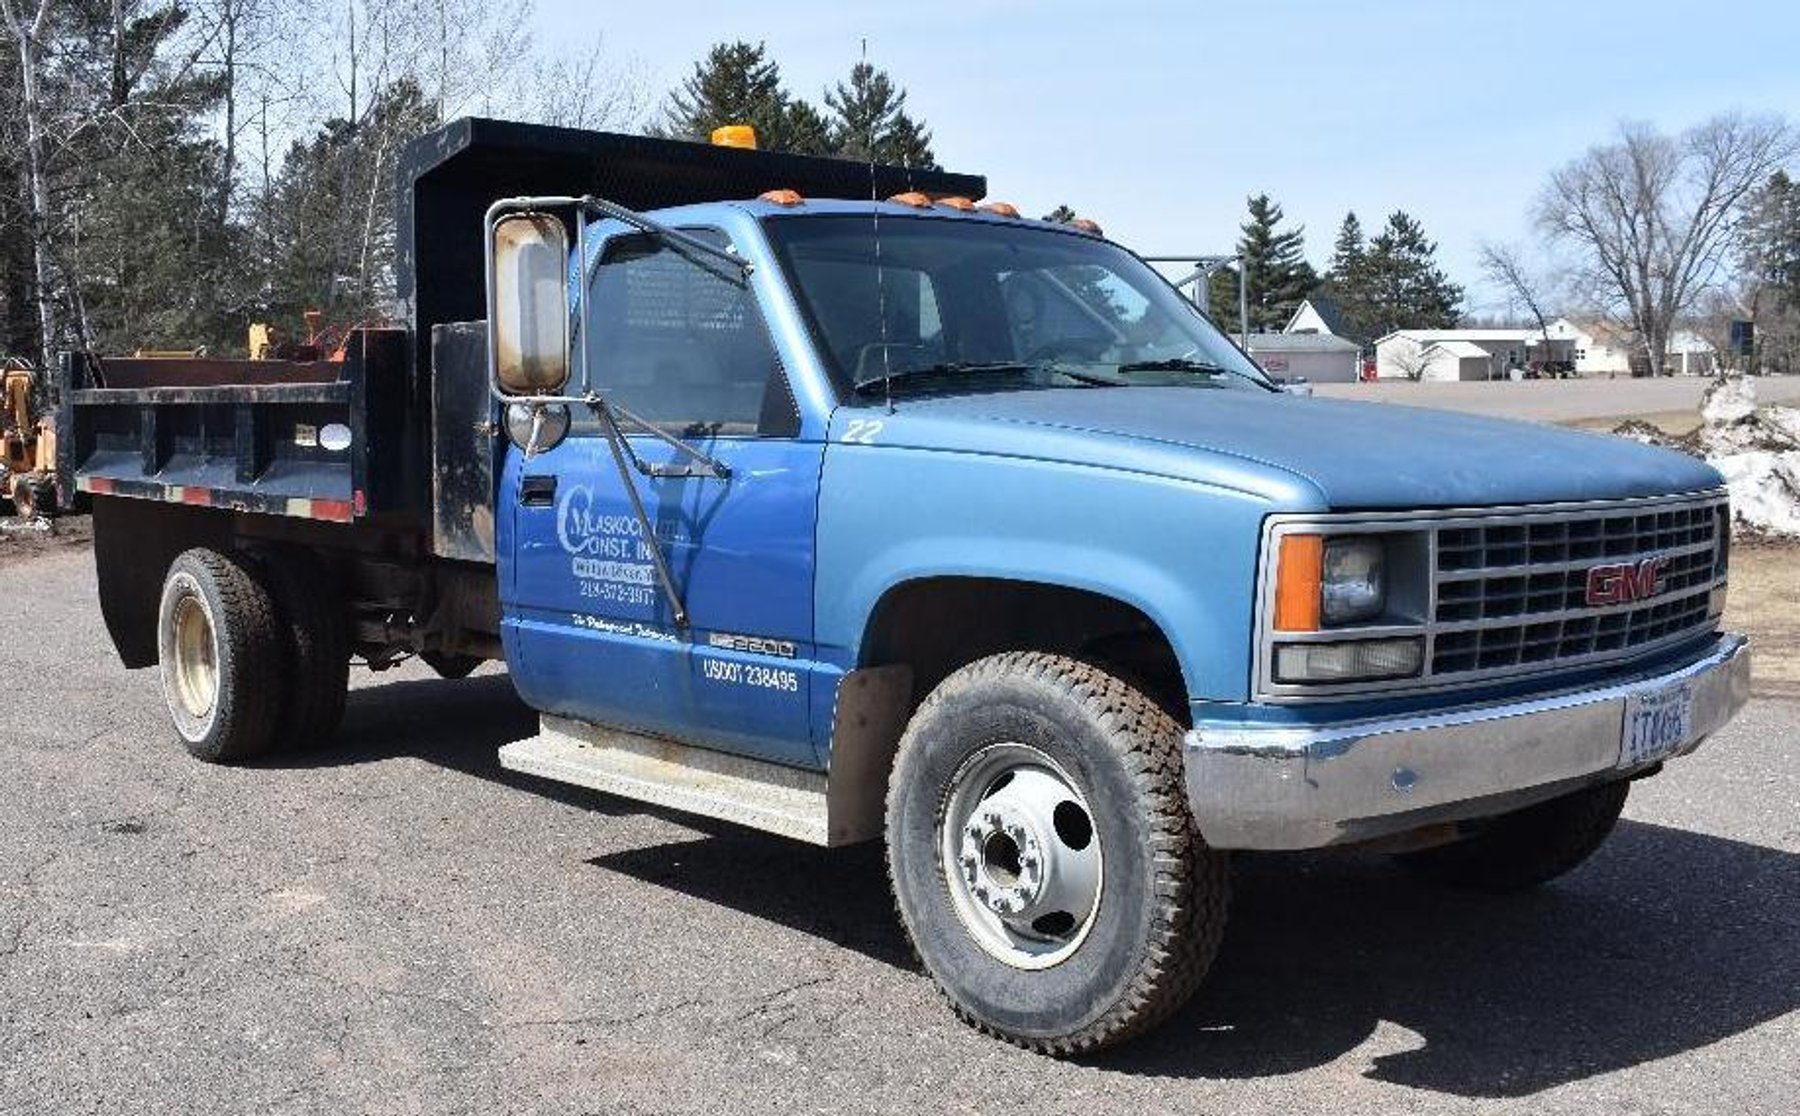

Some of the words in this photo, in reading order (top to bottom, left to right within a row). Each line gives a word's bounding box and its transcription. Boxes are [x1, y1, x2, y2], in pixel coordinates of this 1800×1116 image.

[841, 419, 884, 444] 22
[1586, 556, 1666, 605] GMC
[703, 658, 743, 684] USDOT
[745, 664, 798, 692] 238495
